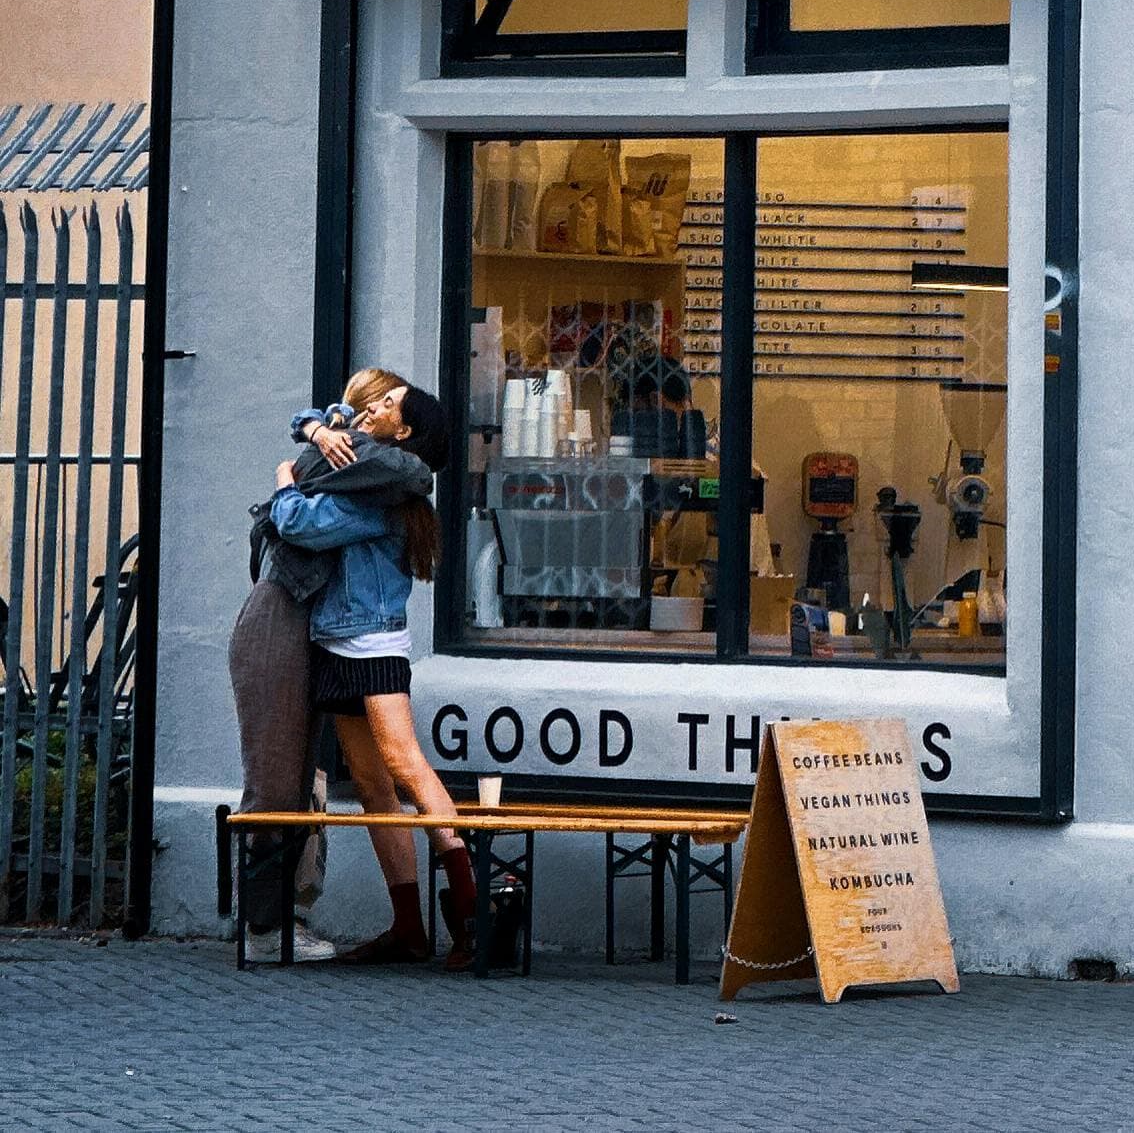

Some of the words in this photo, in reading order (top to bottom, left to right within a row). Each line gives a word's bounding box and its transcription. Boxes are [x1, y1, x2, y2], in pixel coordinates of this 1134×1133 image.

[692, 192, 785, 202] ESPSO
[690, 213, 723, 222] LON
[758, 213, 805, 224] LACK
[689, 233, 723, 243] SHO
[759, 234, 817, 246] WHITE
[686, 254, 718, 265] FLA
[756, 256, 800, 267] HITE
[756, 277, 799, 288] HITE
[755, 299, 822, 309] FILTER
[431, 704, 634, 766] GOOD
[677, 712, 952, 782] THS
[792, 753, 851, 770] COFFEE
[854, 751, 904, 767] BEANS
[800, 794, 851, 810] VEGAN
[855, 791, 911, 807] THINGS
[807, 833, 877, 851] NATURAL
[880, 831, 920, 846] WINE
[830, 872, 915, 891] KOMBUCHA
